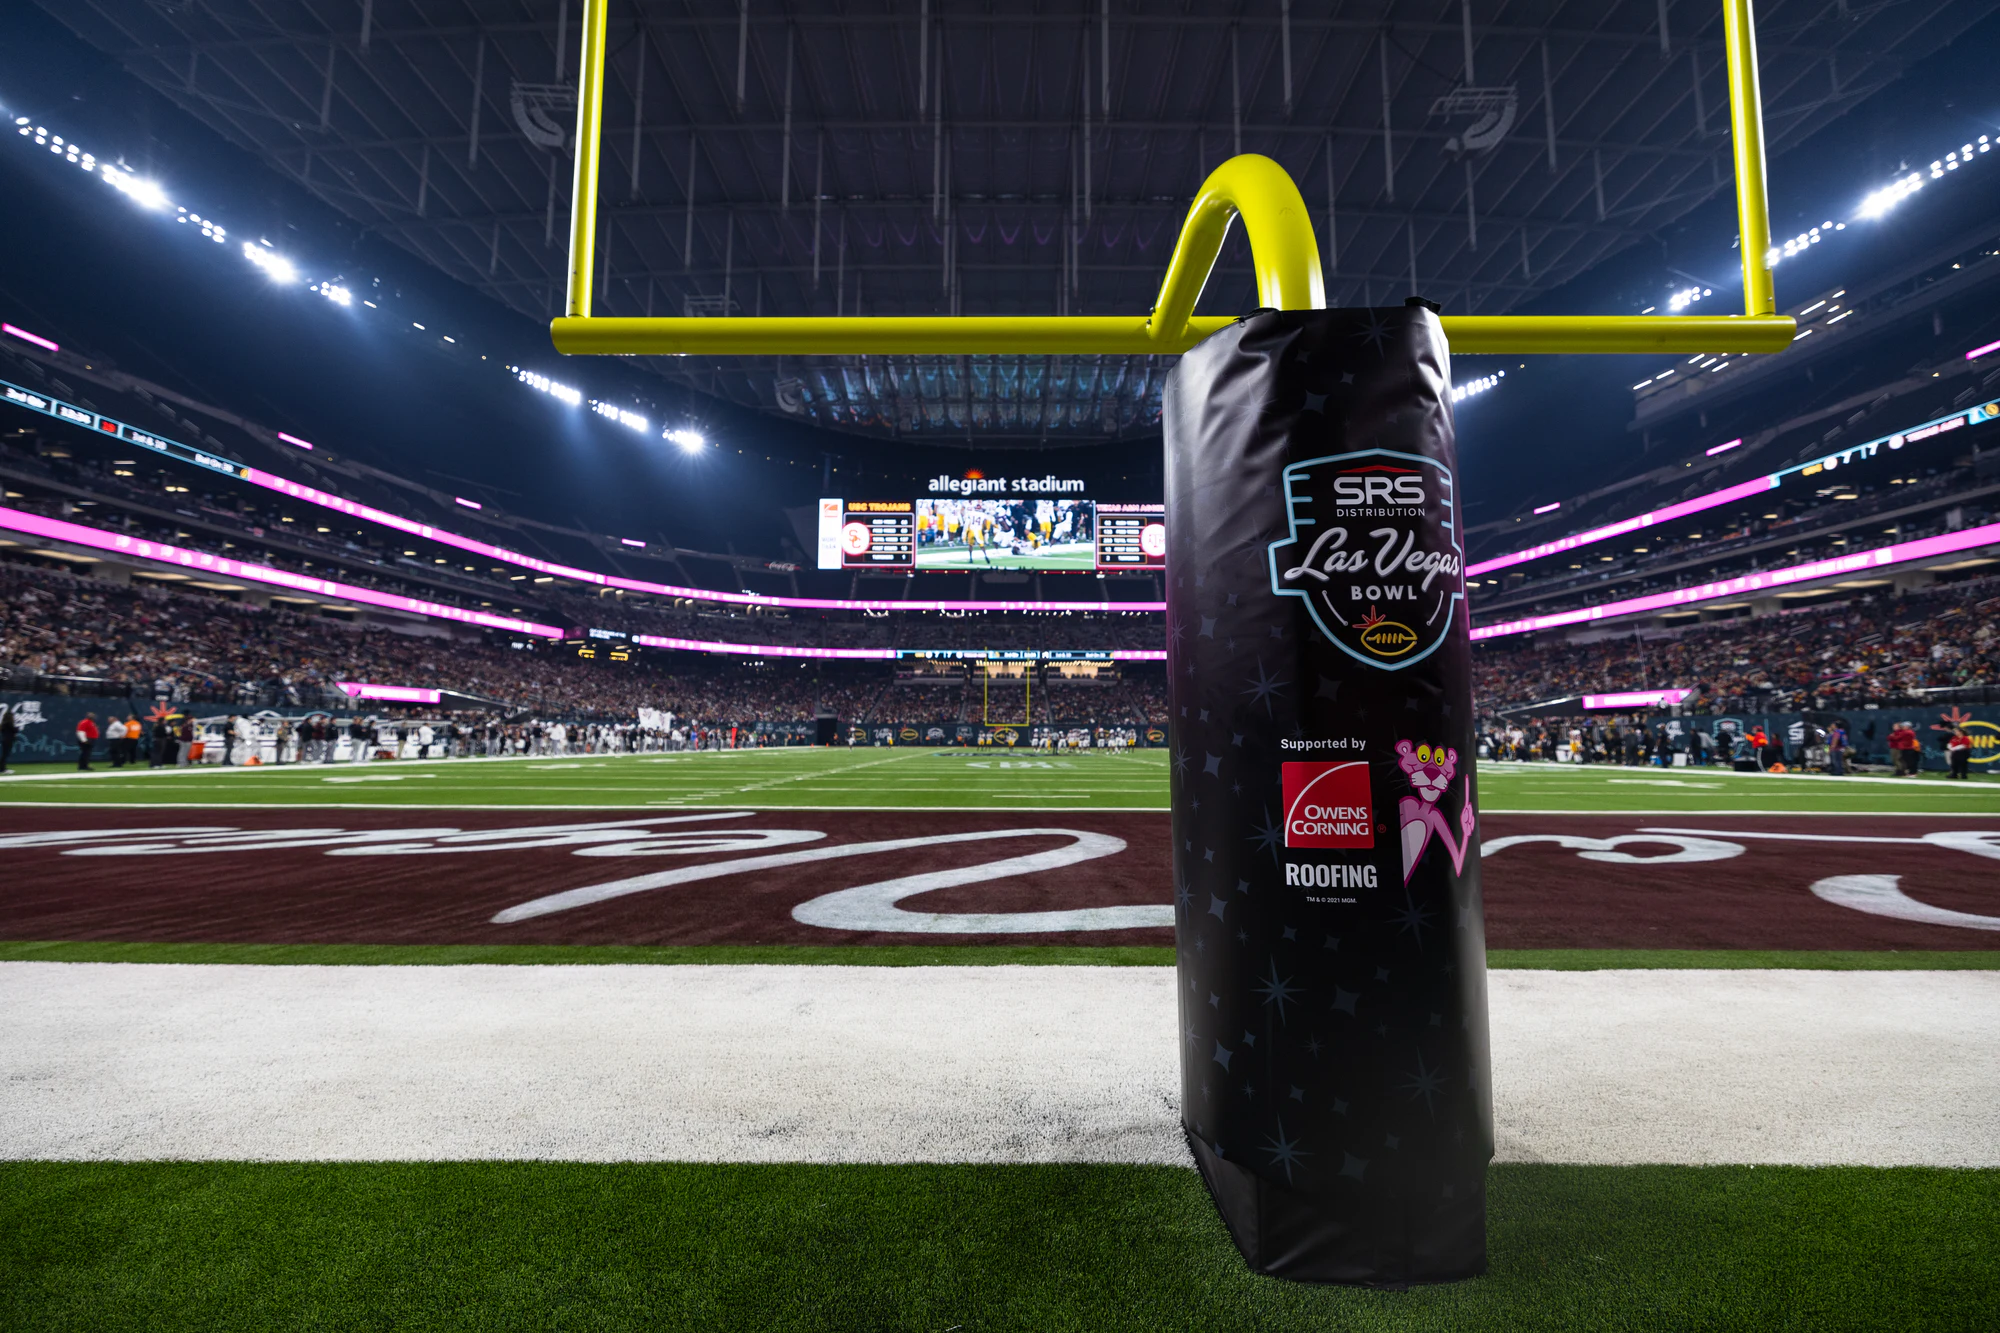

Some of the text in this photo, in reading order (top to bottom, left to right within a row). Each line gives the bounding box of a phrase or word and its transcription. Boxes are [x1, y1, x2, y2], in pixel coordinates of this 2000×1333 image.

[928, 474, 1085, 496] allegiant stadium
[1333, 476, 1426, 505] SRS
[1336, 508, 1426, 517] DISTRIBUTION
[1284, 527, 1459, 593] Las Vegas
[1351, 585, 1418, 601] BOWL
[1281, 738, 1366, 751] Supported by
[1304, 805, 1368, 820] OWENS
[1291, 820, 1369, 836] CORNING
[1285, 863, 1378, 888] ROOFING
